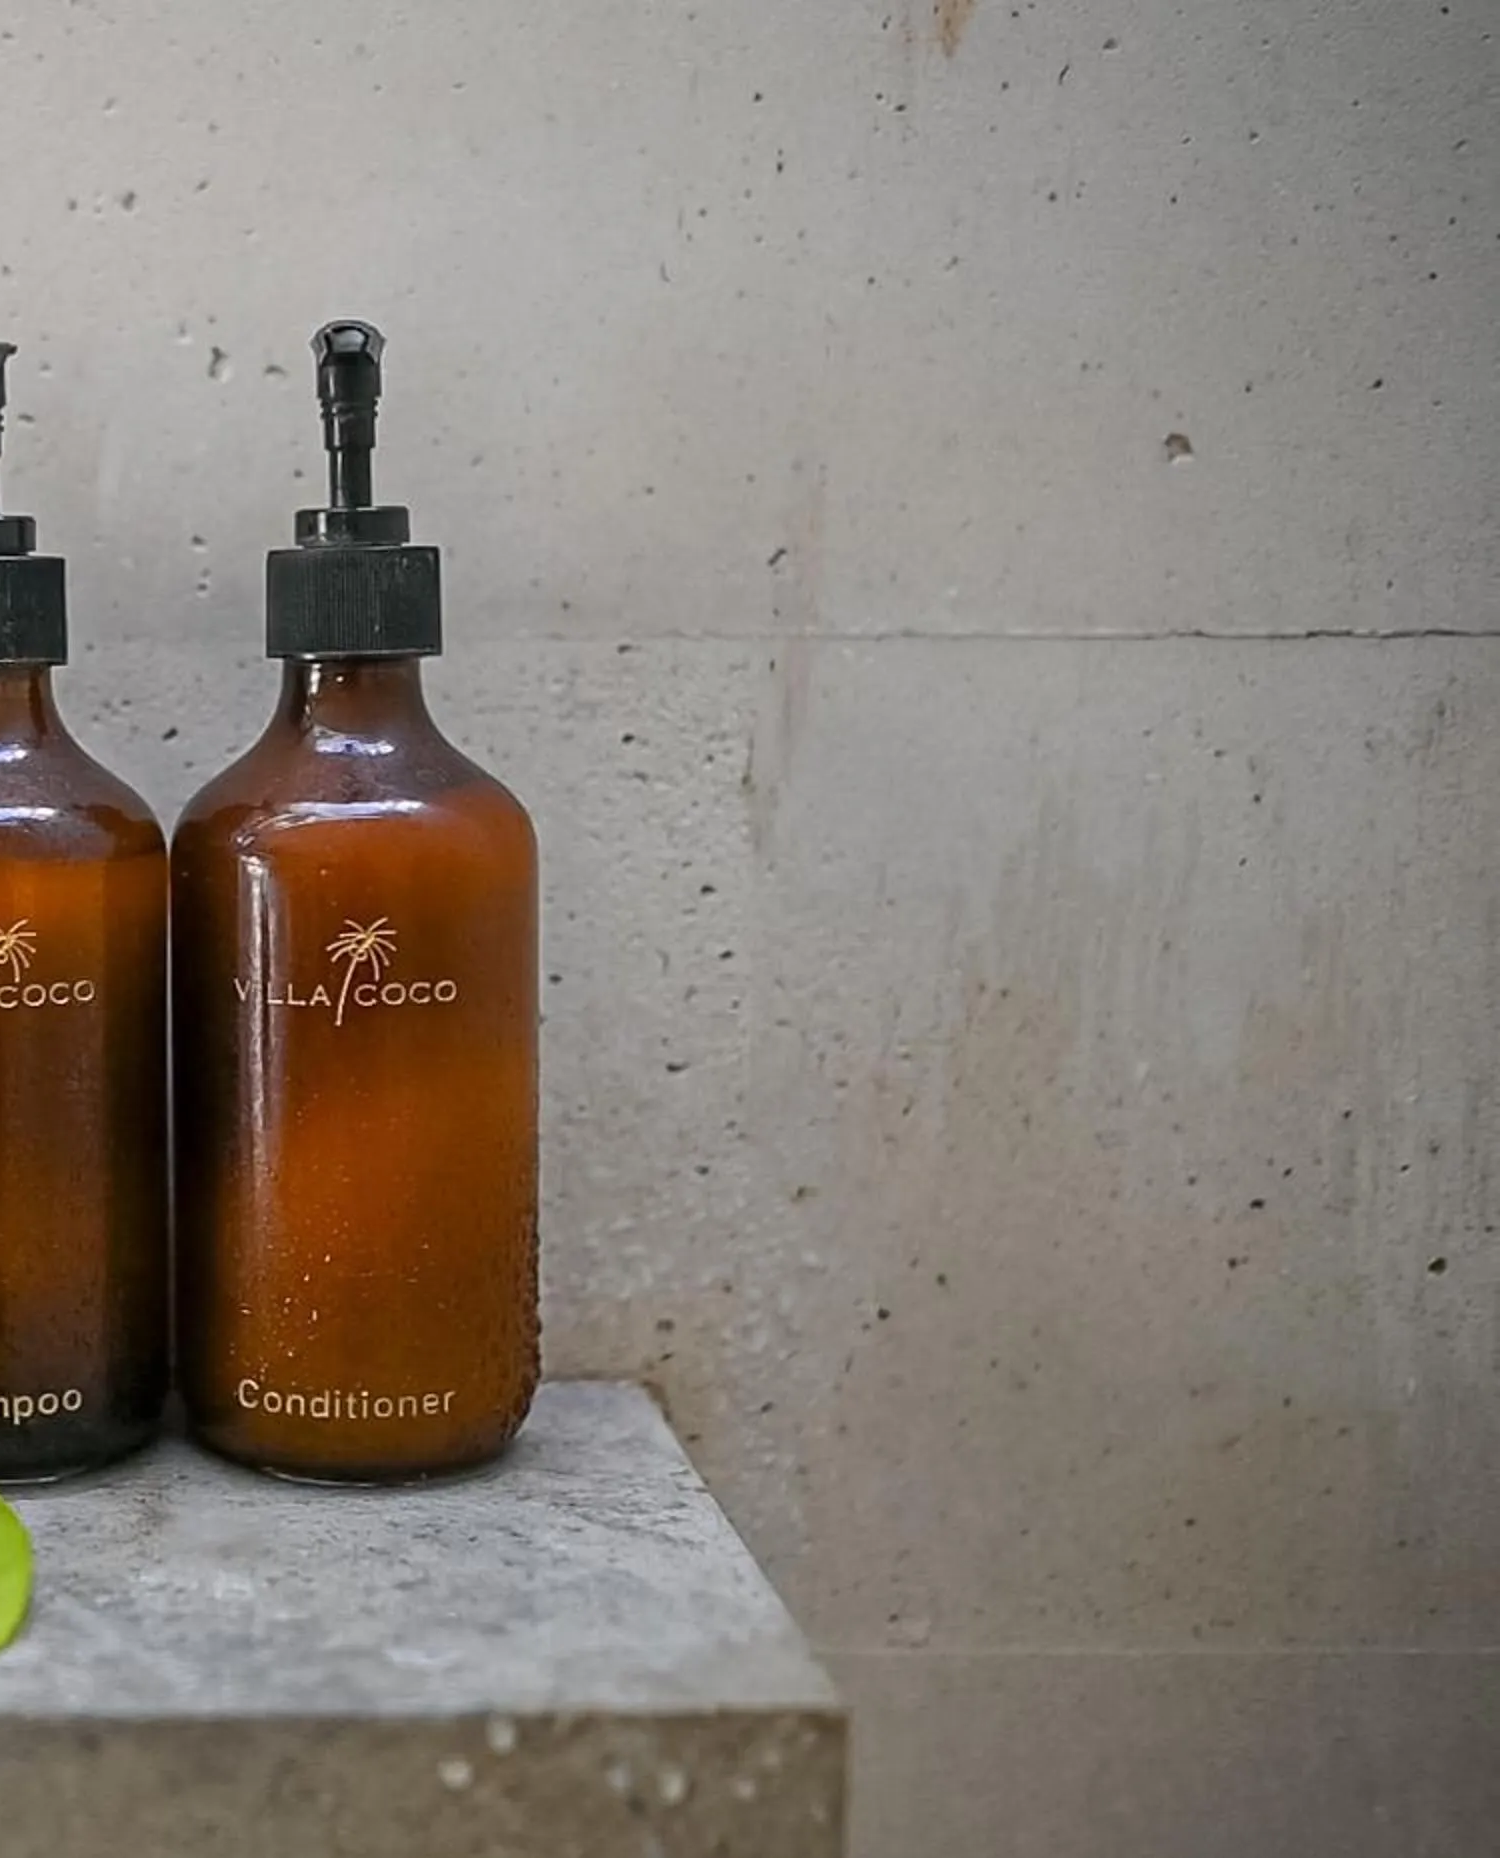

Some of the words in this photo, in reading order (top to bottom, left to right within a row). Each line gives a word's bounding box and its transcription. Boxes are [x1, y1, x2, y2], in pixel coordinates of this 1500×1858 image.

[233, 977, 332, 1007] VLLA
[353, 979, 458, 1007] COCO
[237, 1378, 456, 1419] Conditioner
